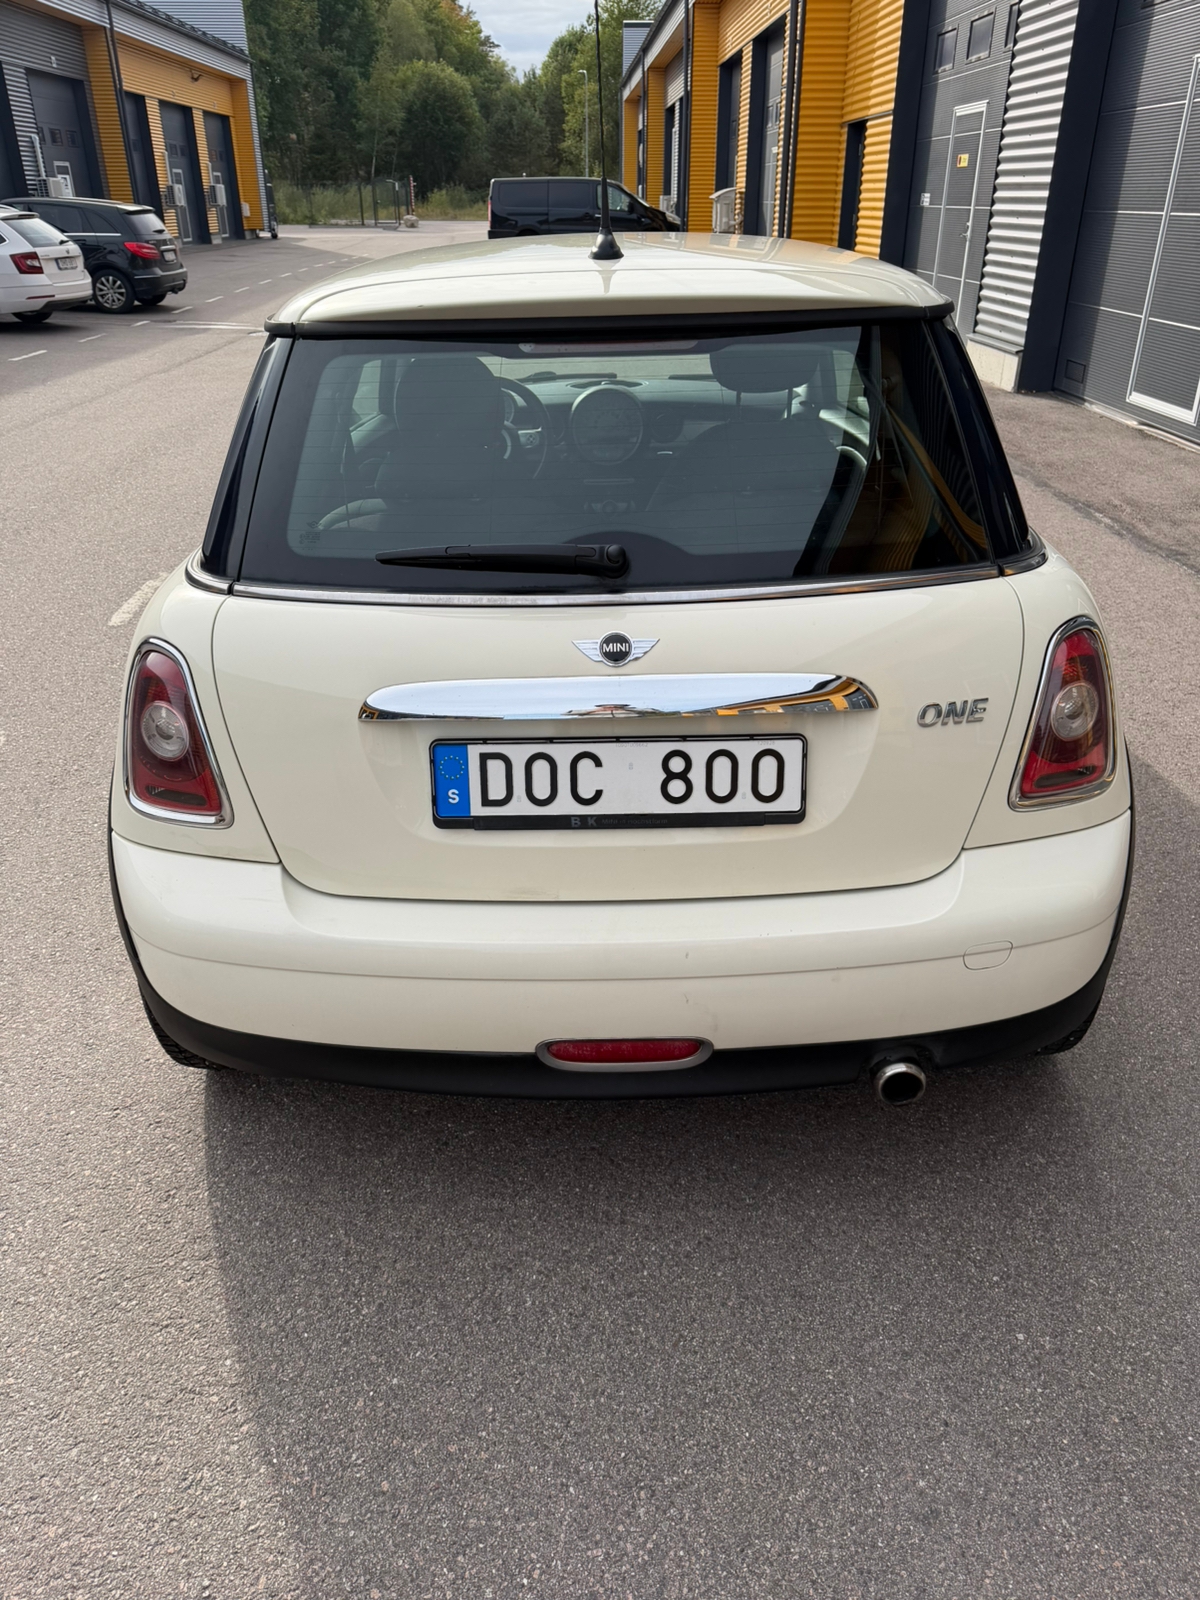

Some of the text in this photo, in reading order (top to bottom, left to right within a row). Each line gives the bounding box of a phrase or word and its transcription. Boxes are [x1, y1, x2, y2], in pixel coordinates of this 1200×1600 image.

[602, 643, 629, 653] MINI
[916, 697, 989, 728] ONE
[479, 748, 786, 807] DOC 800
[447, 788, 460, 804] S
